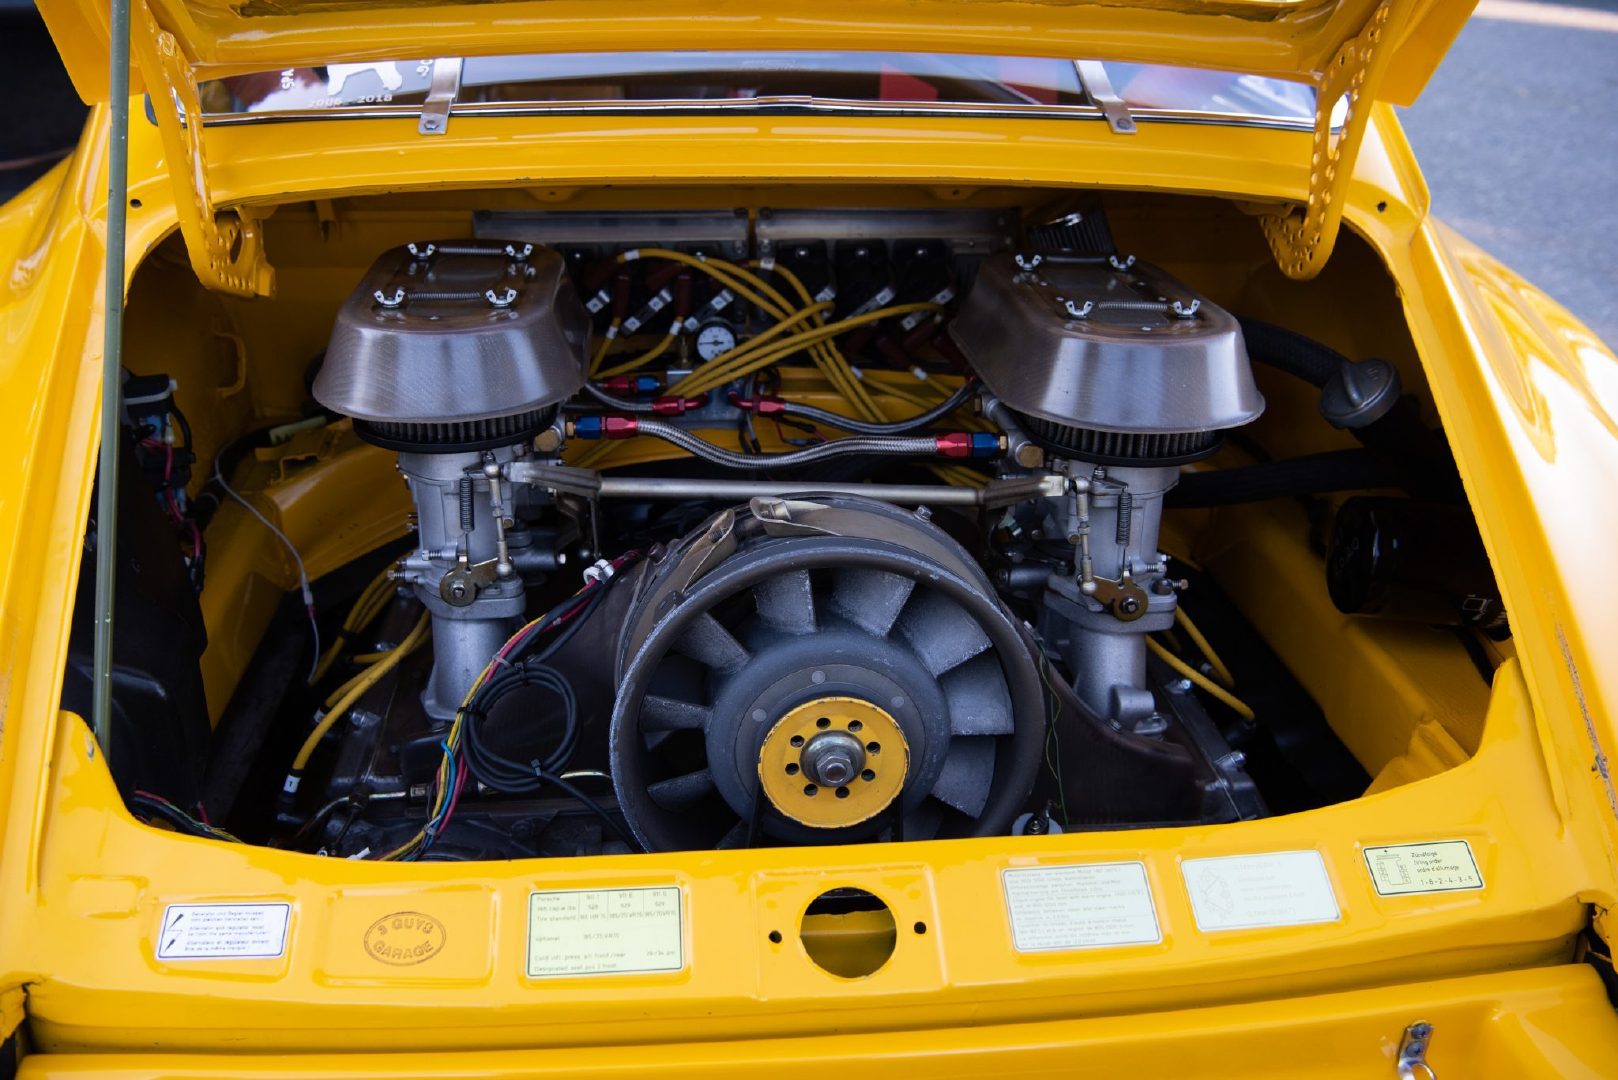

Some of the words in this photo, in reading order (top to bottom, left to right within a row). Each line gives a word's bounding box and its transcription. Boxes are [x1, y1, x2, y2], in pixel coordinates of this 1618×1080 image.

[357, 94, 392, 104] 2018
[392, 918, 434, 934] GUYS
[373, 940, 434, 960] GARAGE
